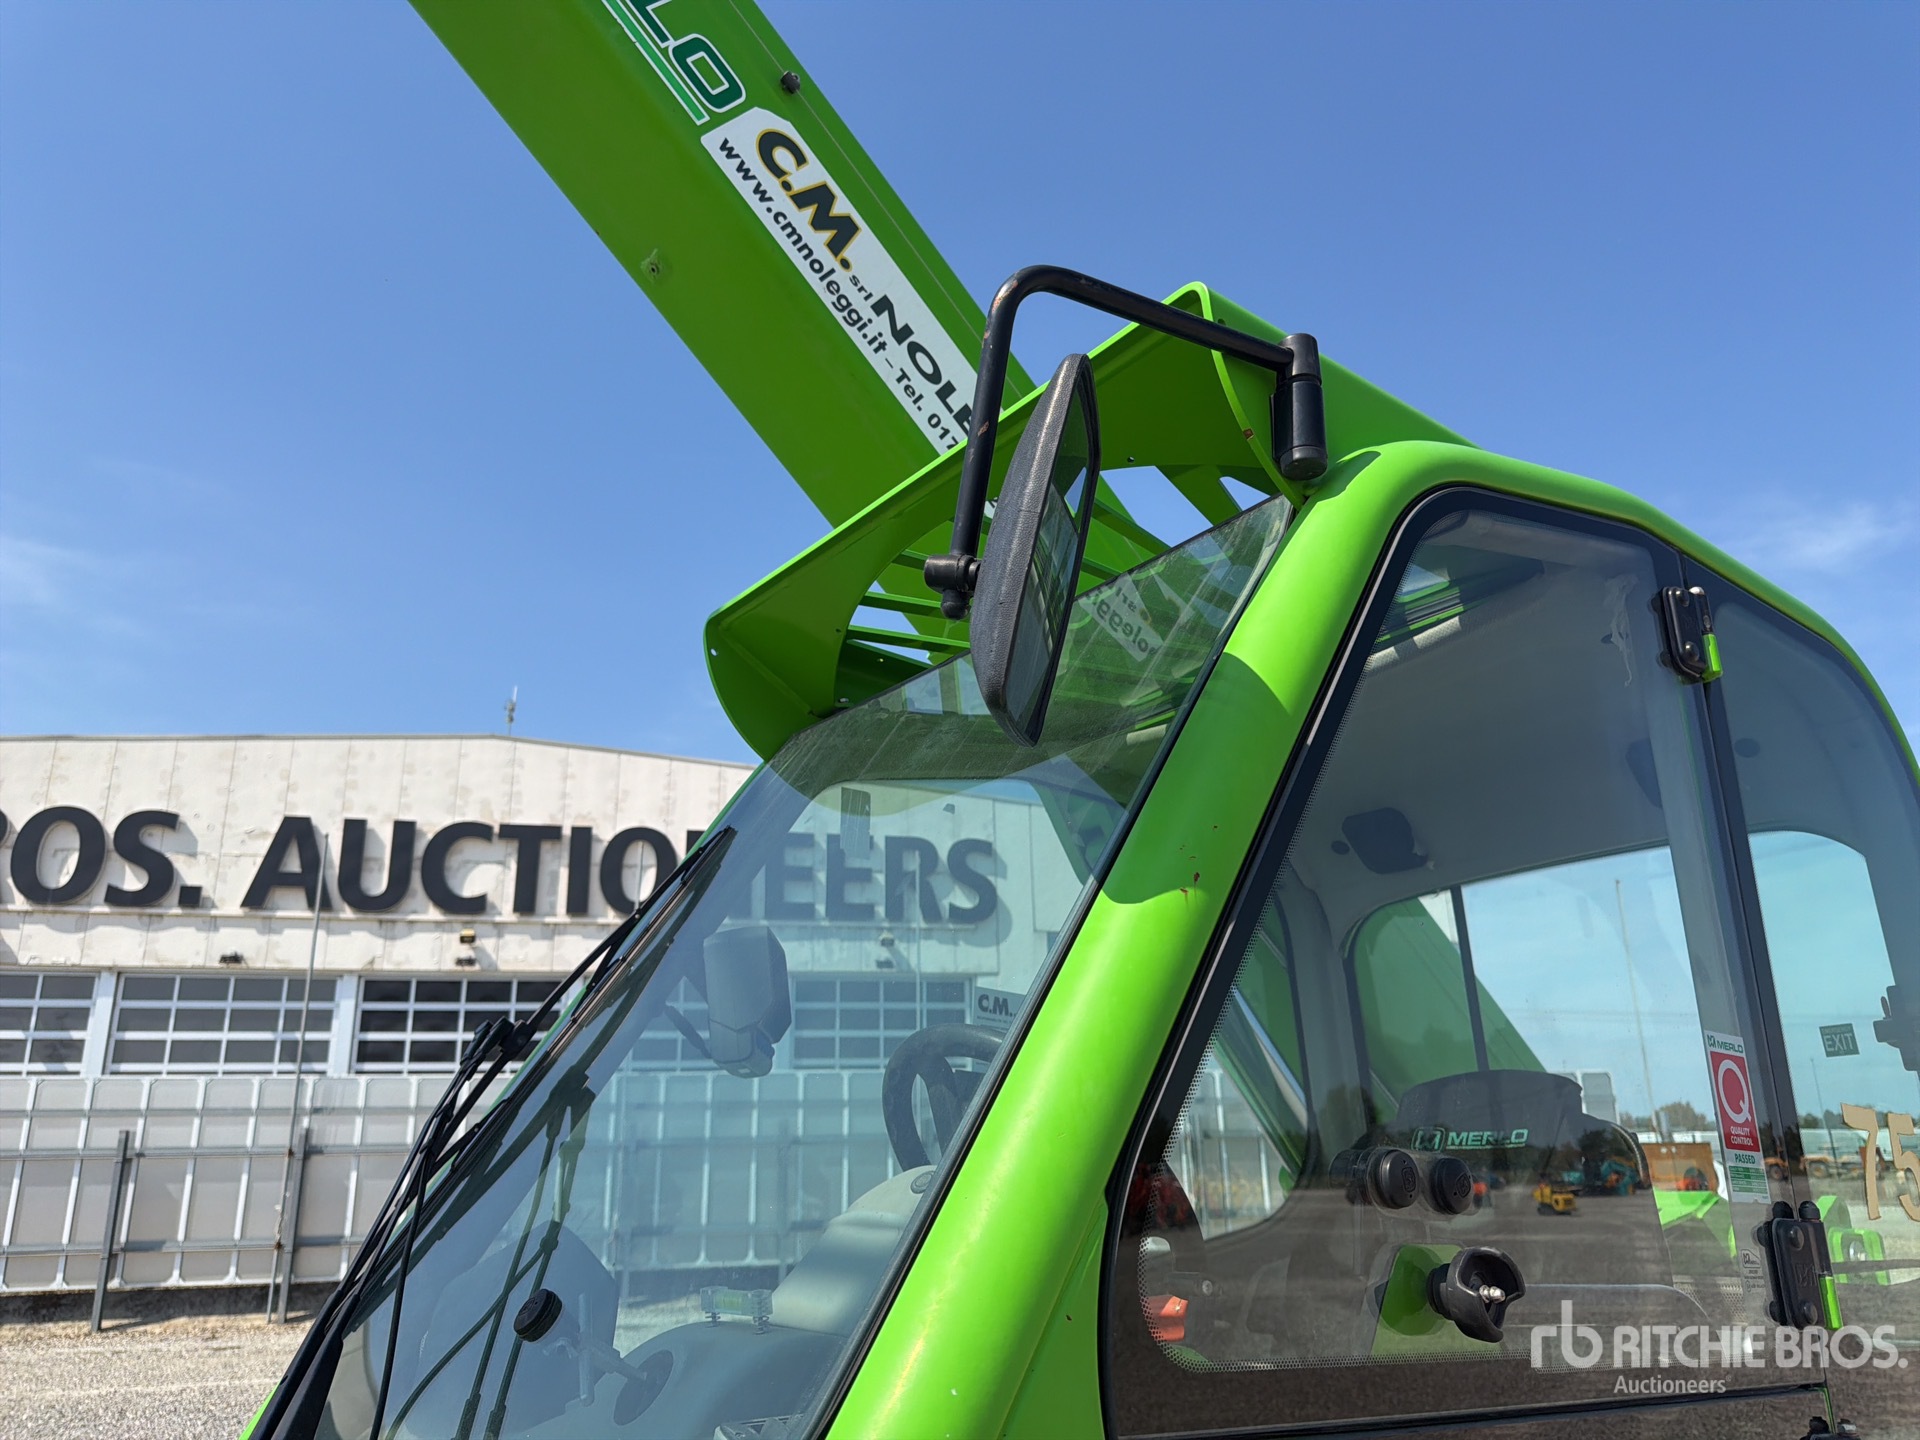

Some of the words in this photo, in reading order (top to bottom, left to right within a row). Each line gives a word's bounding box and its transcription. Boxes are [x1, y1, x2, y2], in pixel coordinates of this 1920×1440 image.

[756, 128, 862, 272] C.M.
[849, 274, 874, 302] srl
[719, 137, 888, 355] www.cmnoleggi.it
[895, 367, 925, 412] Tel.
[0, 806, 203, 908] OS.
[240, 815, 998, 925] AUCTIOEERS
[1717, 1041, 1744, 1054] MERLO
[1823, 1033, 1854, 1052] EXIT
[1730, 1126, 1750, 1136] QUALITY
[1730, 1136, 1754, 1146] CONTROL
[1734, 1153, 1756, 1165] PASSED
